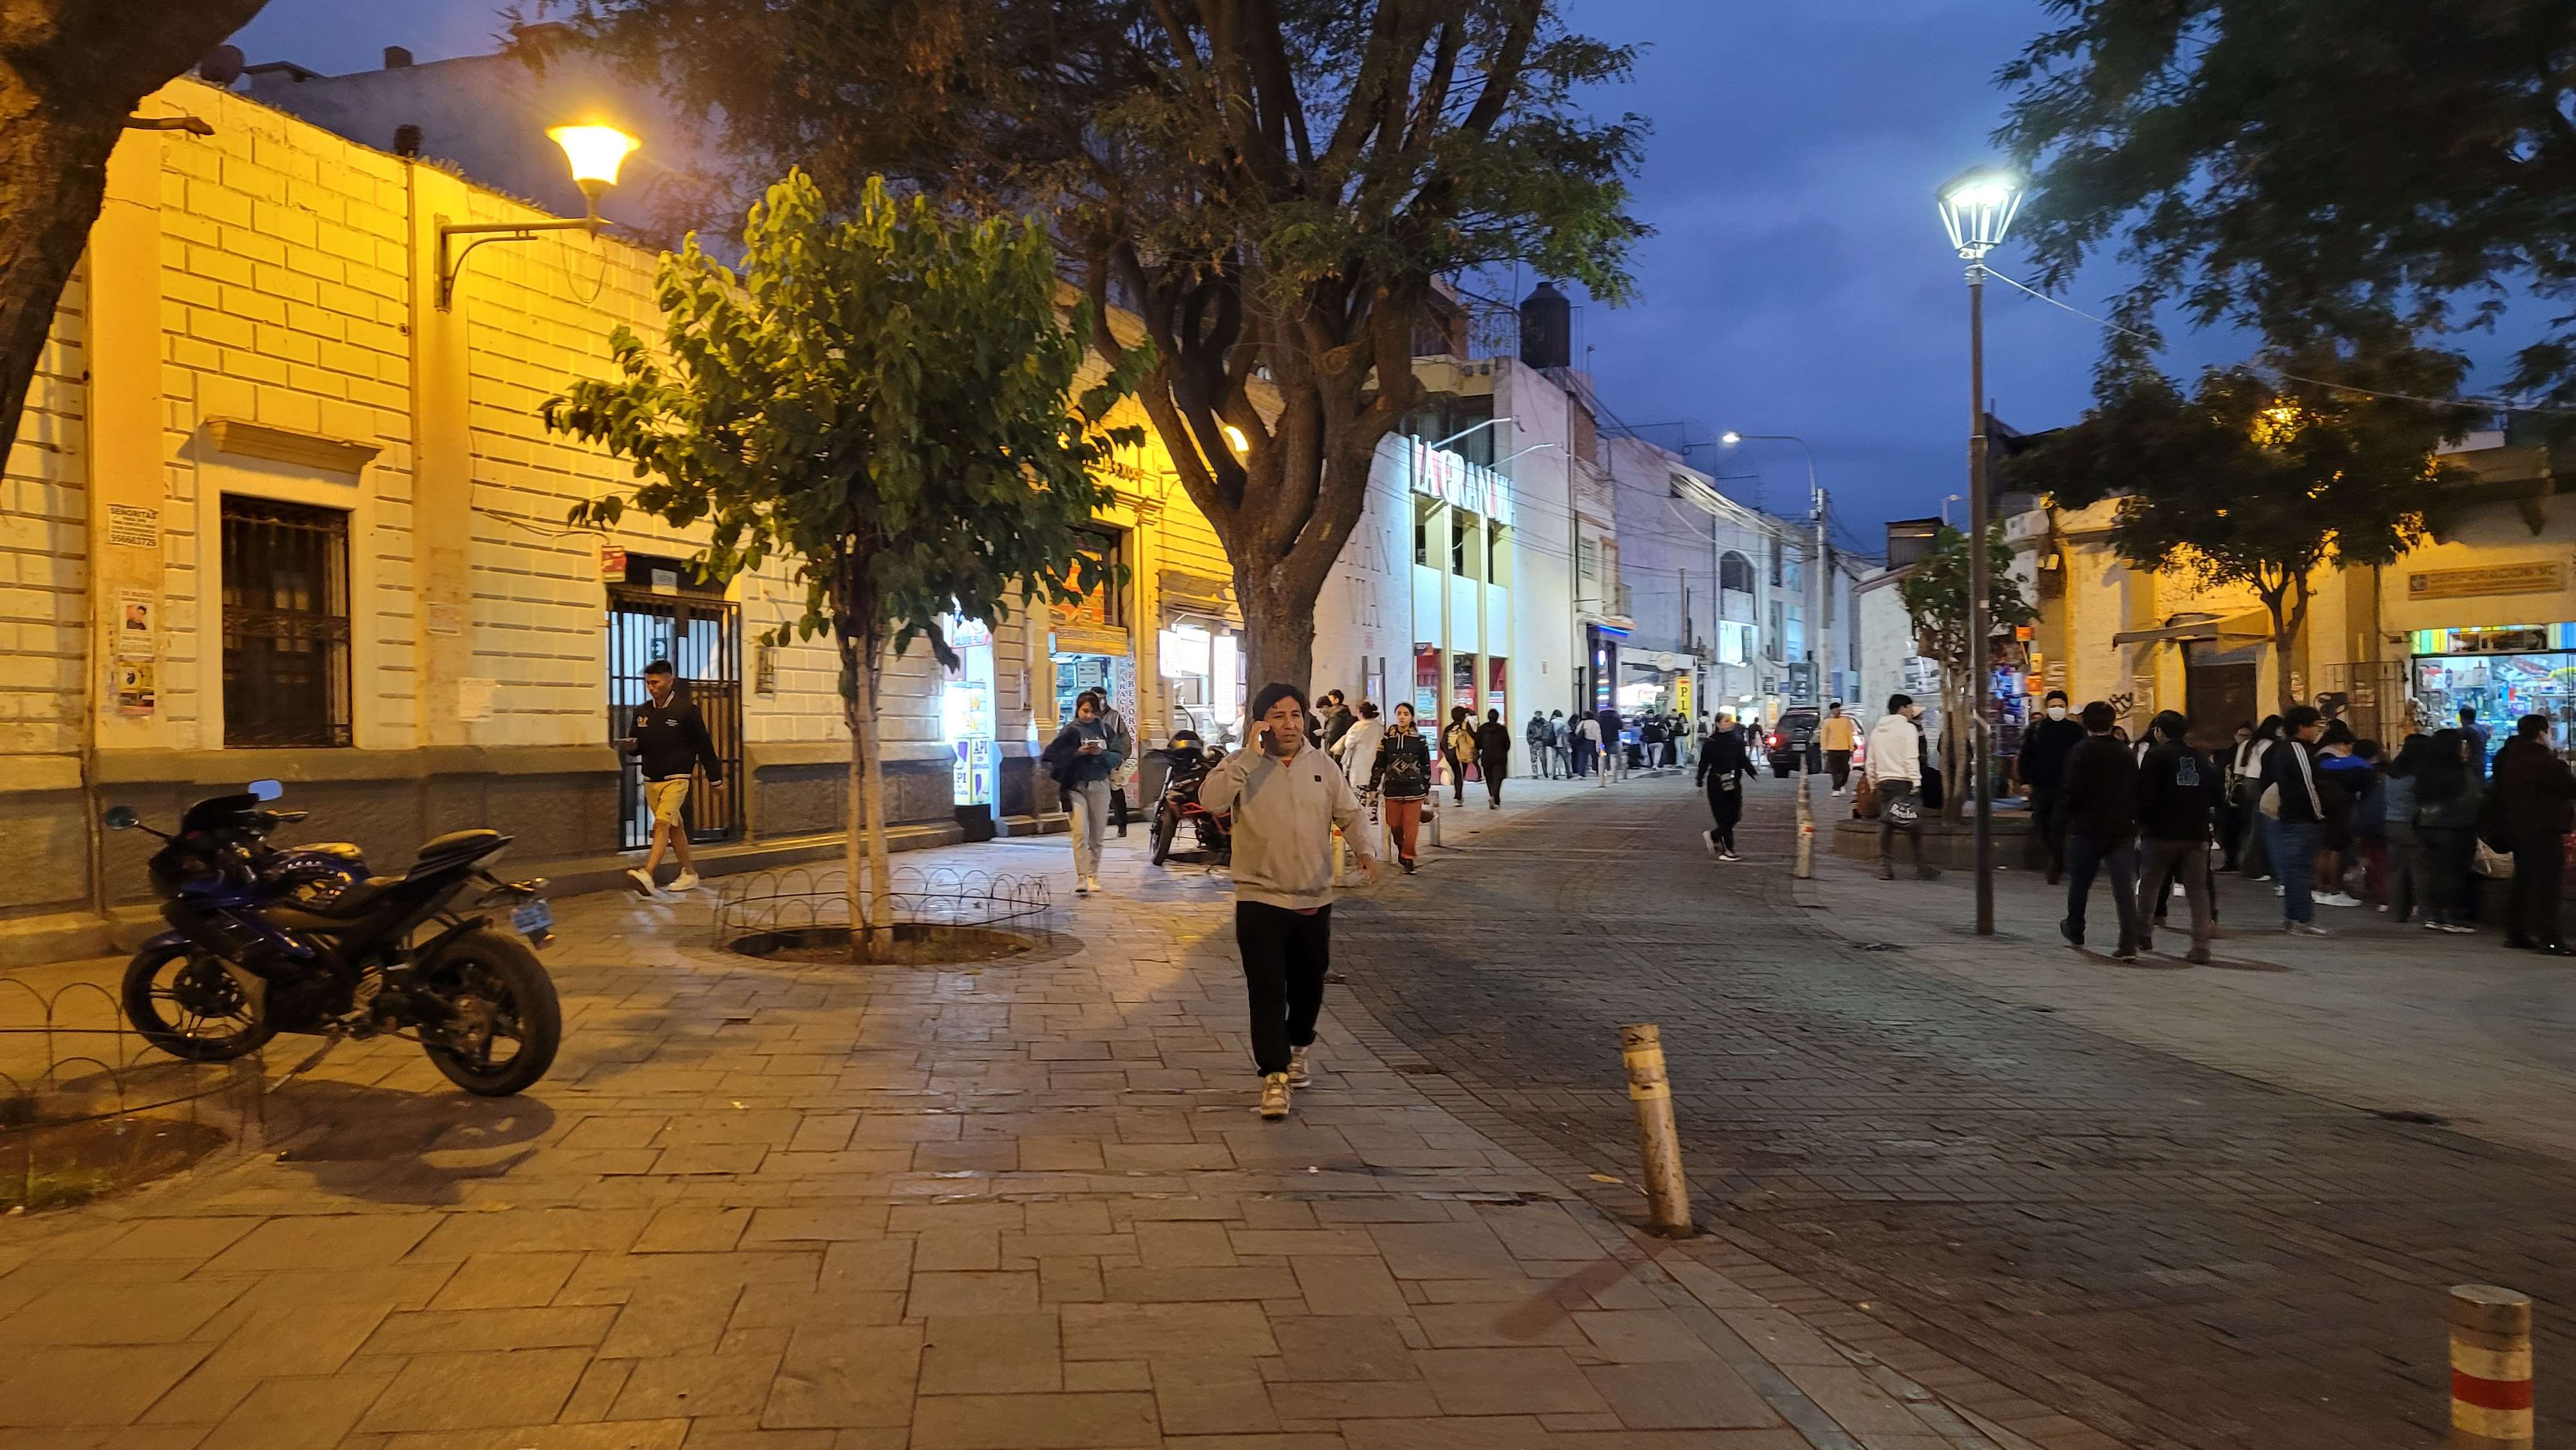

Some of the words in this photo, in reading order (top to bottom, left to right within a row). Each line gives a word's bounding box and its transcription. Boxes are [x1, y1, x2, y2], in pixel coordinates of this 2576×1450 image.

[1410, 434, 1443, 498] LA
[1439, 449, 1495, 518] GRAN
[973, 740, 988, 755] API
[953, 772, 967, 783] PI
